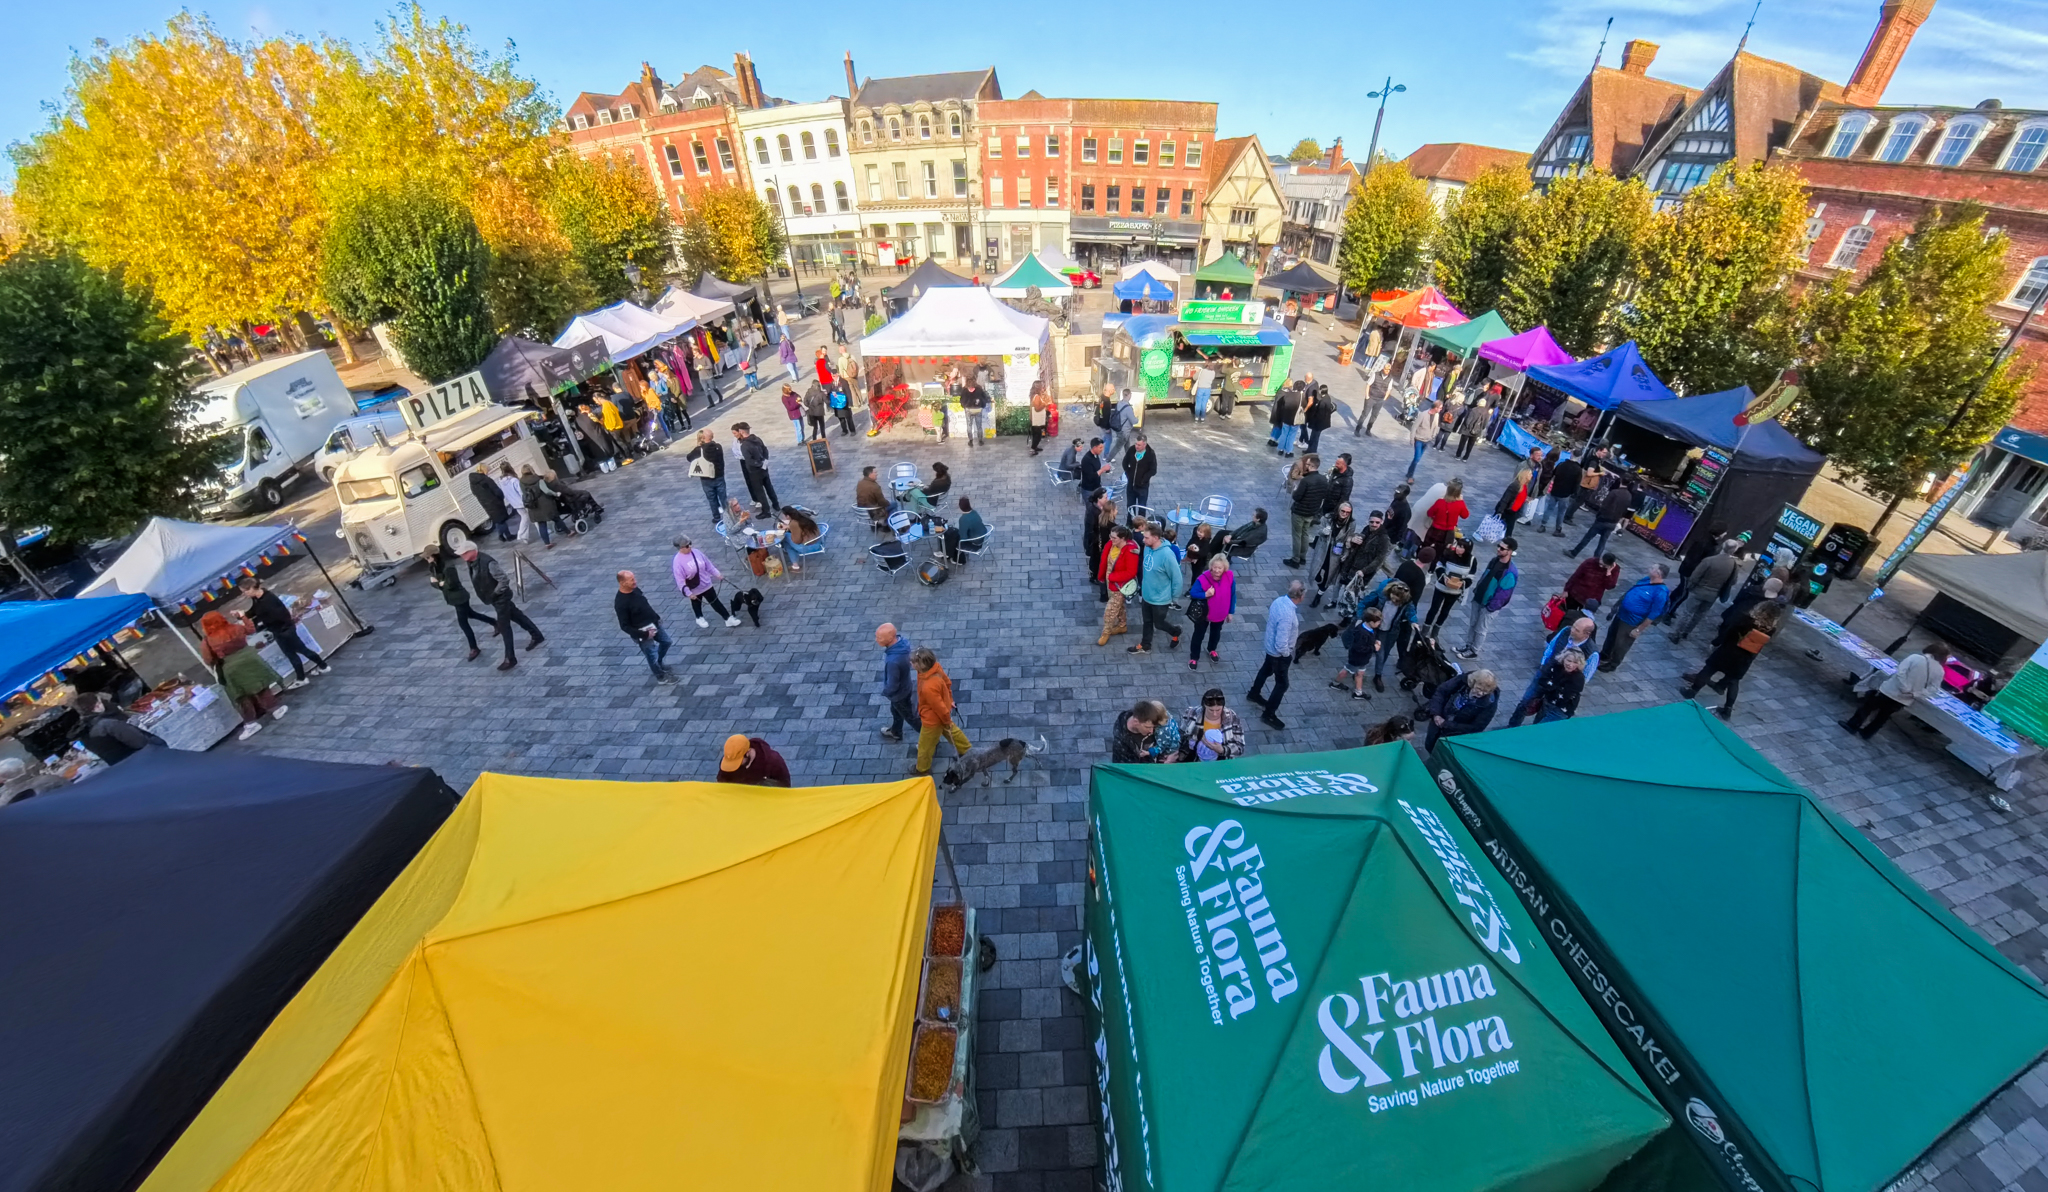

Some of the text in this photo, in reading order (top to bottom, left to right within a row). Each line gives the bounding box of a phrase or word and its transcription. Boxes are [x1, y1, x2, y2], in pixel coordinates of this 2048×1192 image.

[950, 213, 979, 221] NatWst
[1108, 221, 1162, 230] PIZZAEXPR
[408, 376, 486, 428] PIZZA
[1778, 516, 1815, 540] RUNNERS
[1782, 508, 1820, 534] VEGAN
[1220, 775, 1320, 794] Flora
[1232, 785, 1354, 806] Fauna
[1397, 798, 1477, 910] Fauna
[1416, 806, 1485, 896] Flora
[1176, 865, 1224, 1026] Saving Nature Together
[1184, 819, 1256, 1020] & Flora
[1227, 843, 1298, 1004] Fauna
[1484, 838, 1681, 1086] ARTISAN CHEESECAKE!
[1113, 929, 1139, 1064] member
[1358, 963, 1497, 1026] Fauna
[1317, 993, 1514, 1094] & Flora
[1368, 1059, 1520, 1114] Saving Nature Together
